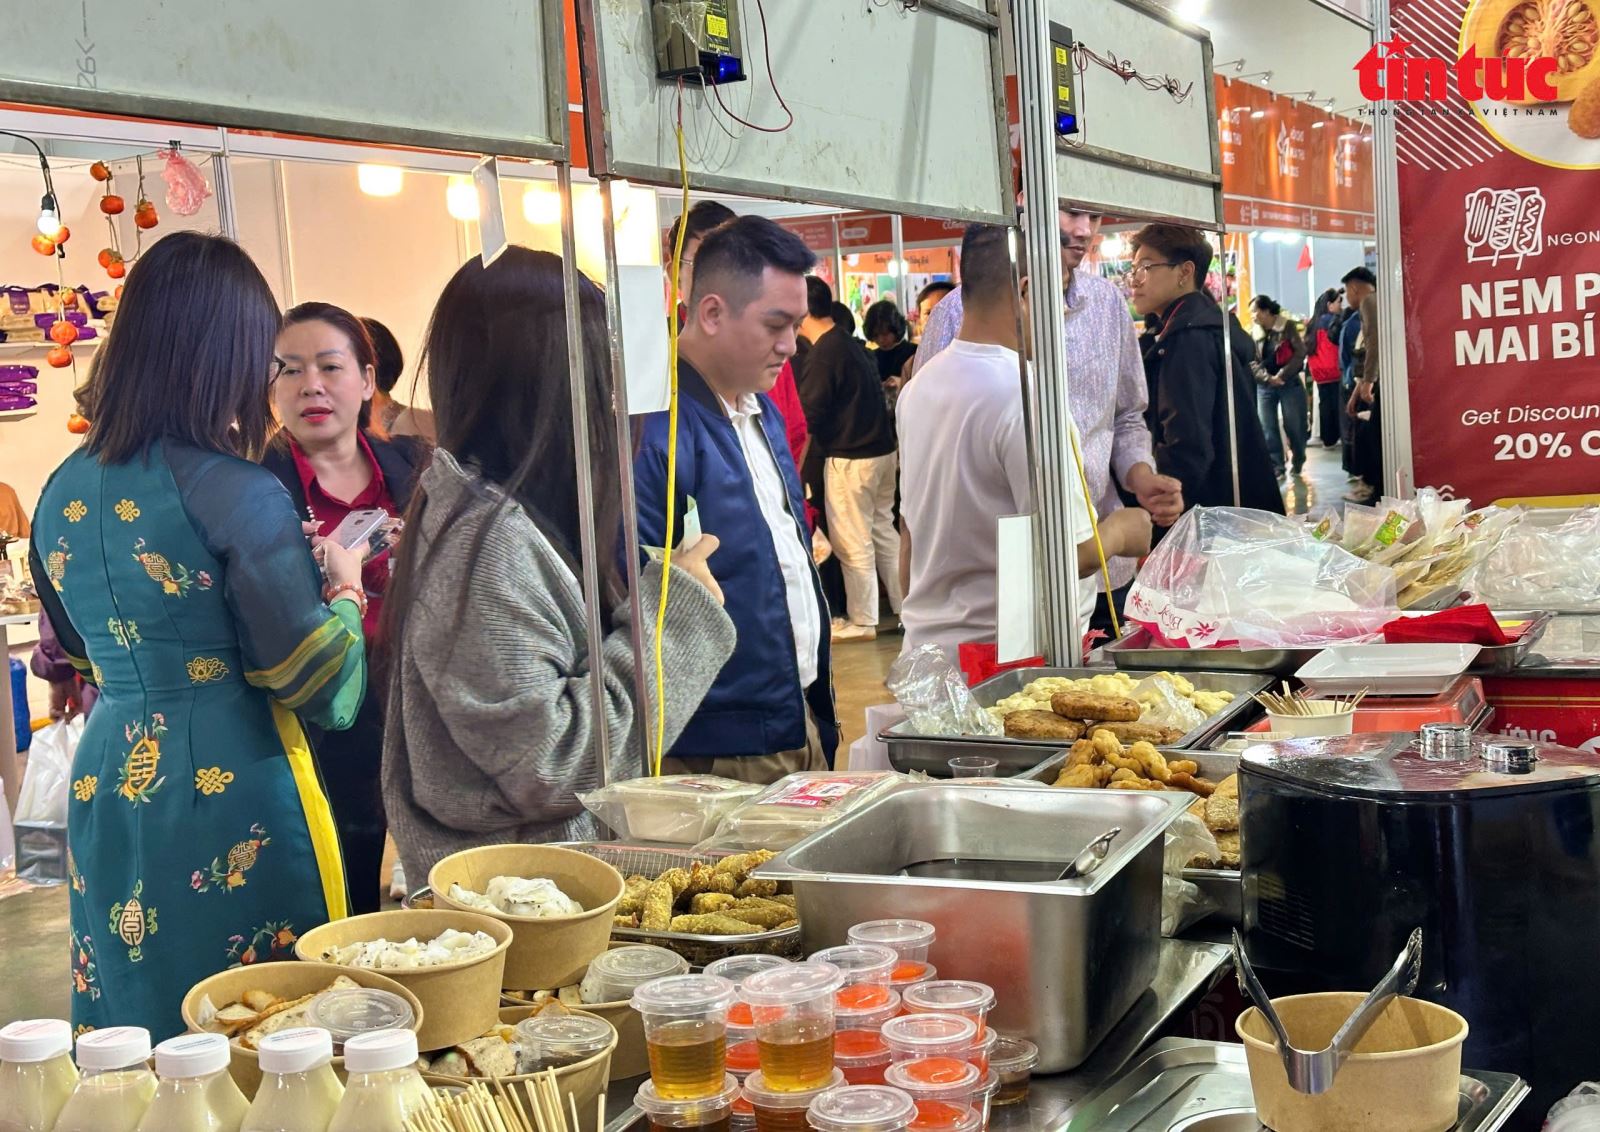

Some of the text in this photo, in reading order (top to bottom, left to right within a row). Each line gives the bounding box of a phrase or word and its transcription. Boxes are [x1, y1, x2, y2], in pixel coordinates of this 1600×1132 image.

[1547, 230, 1600, 247] NGON
[1461, 275, 1563, 320] NEM
[1454, 312, 1596, 366] MAI BÍ
[1461, 408, 1502, 426] Get
[1493, 431, 1573, 461] 20%
